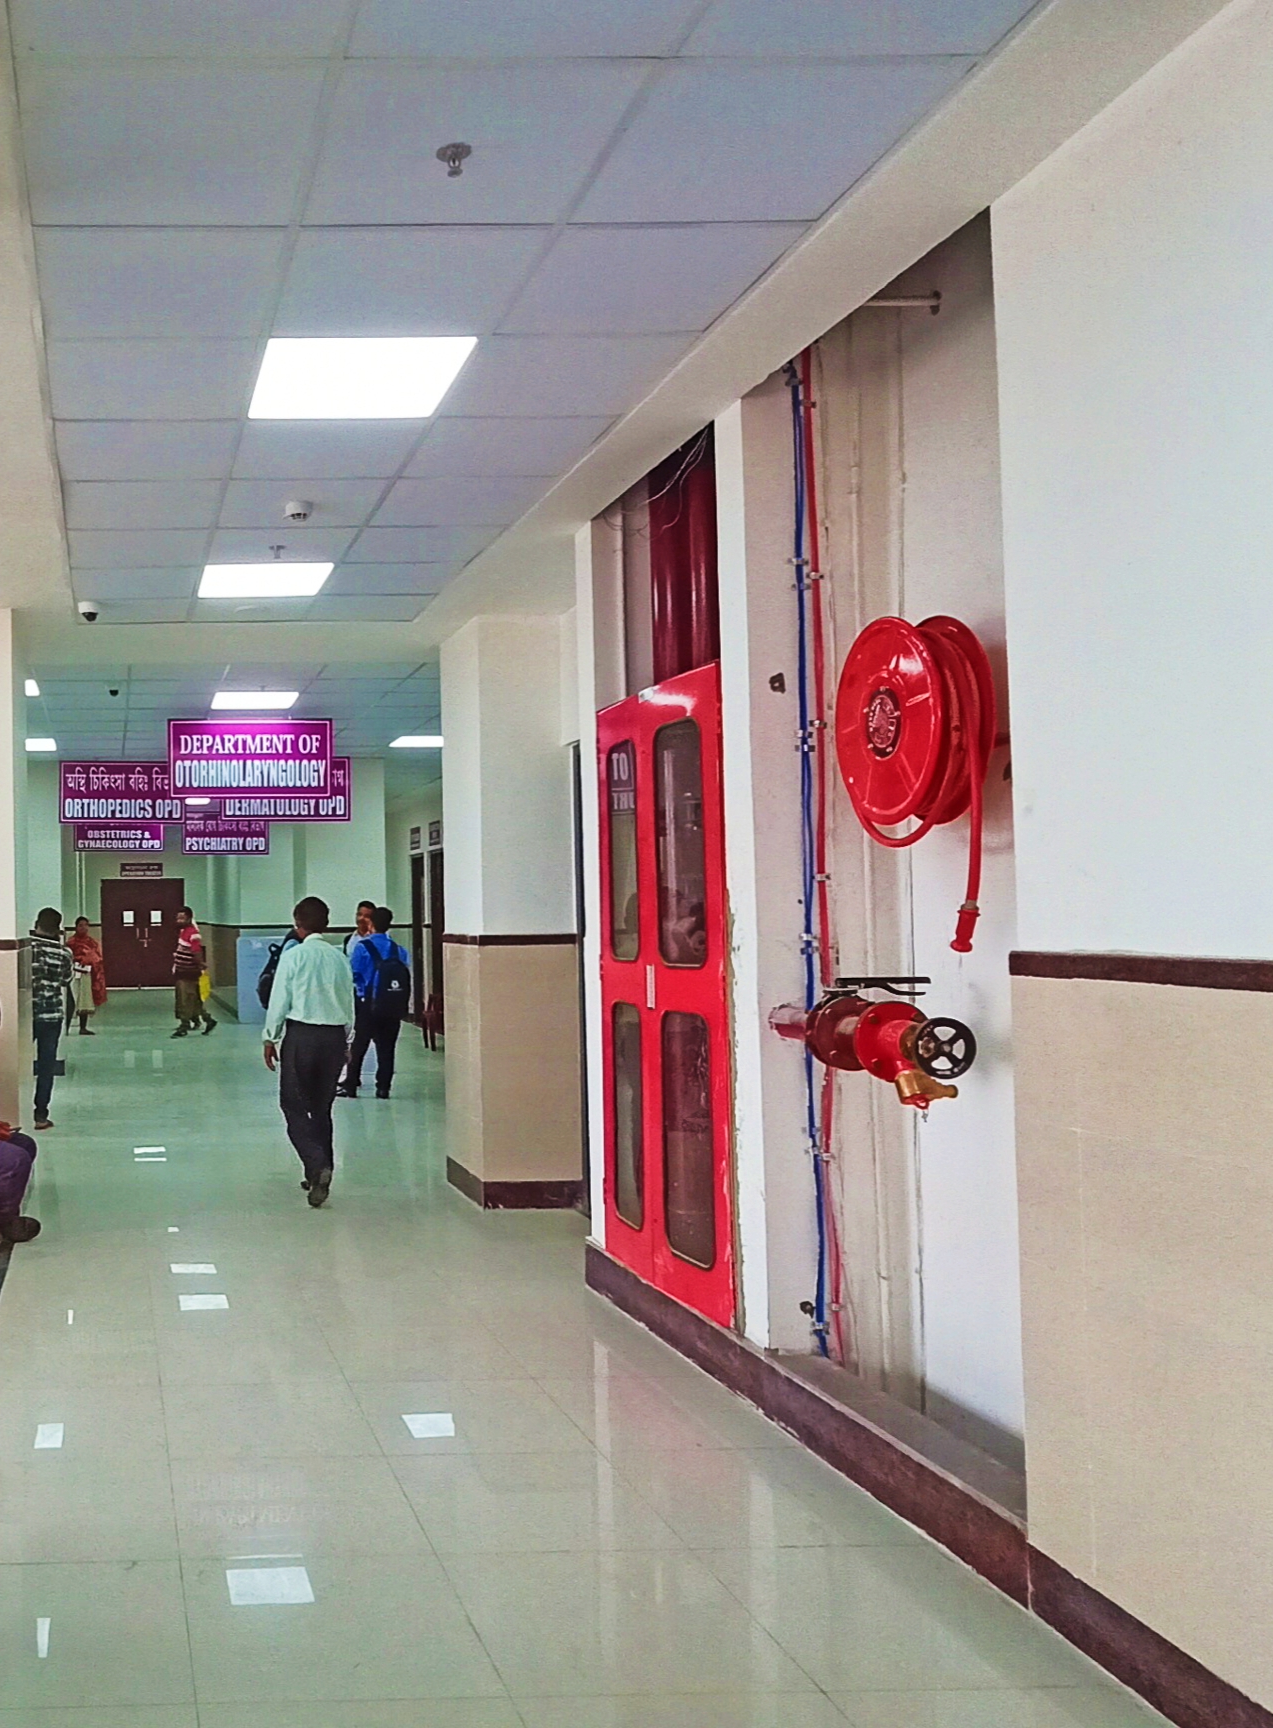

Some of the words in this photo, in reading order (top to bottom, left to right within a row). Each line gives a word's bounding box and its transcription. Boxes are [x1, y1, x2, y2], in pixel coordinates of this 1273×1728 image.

[179, 734, 295, 754] DEPARTMENT
[298, 734, 321, 754] OF
[175, 759, 326, 788] OTORHINOLARYNGOLOGY
[65, 798, 153, 818] ORTHOPEDICS
[155, 799, 181, 818] OPD
[225, 798, 316, 816] DERMATOLOGY
[319, 795, 345, 815] OPD
[78, 840, 140, 849] GYNAECOLOGY
[141, 840, 161, 849] OPD
[87, 830, 142, 839] OBSTETRICS
[185, 837, 244, 851] PSYCHIATRY
[245, 837, 266, 851] OPD
